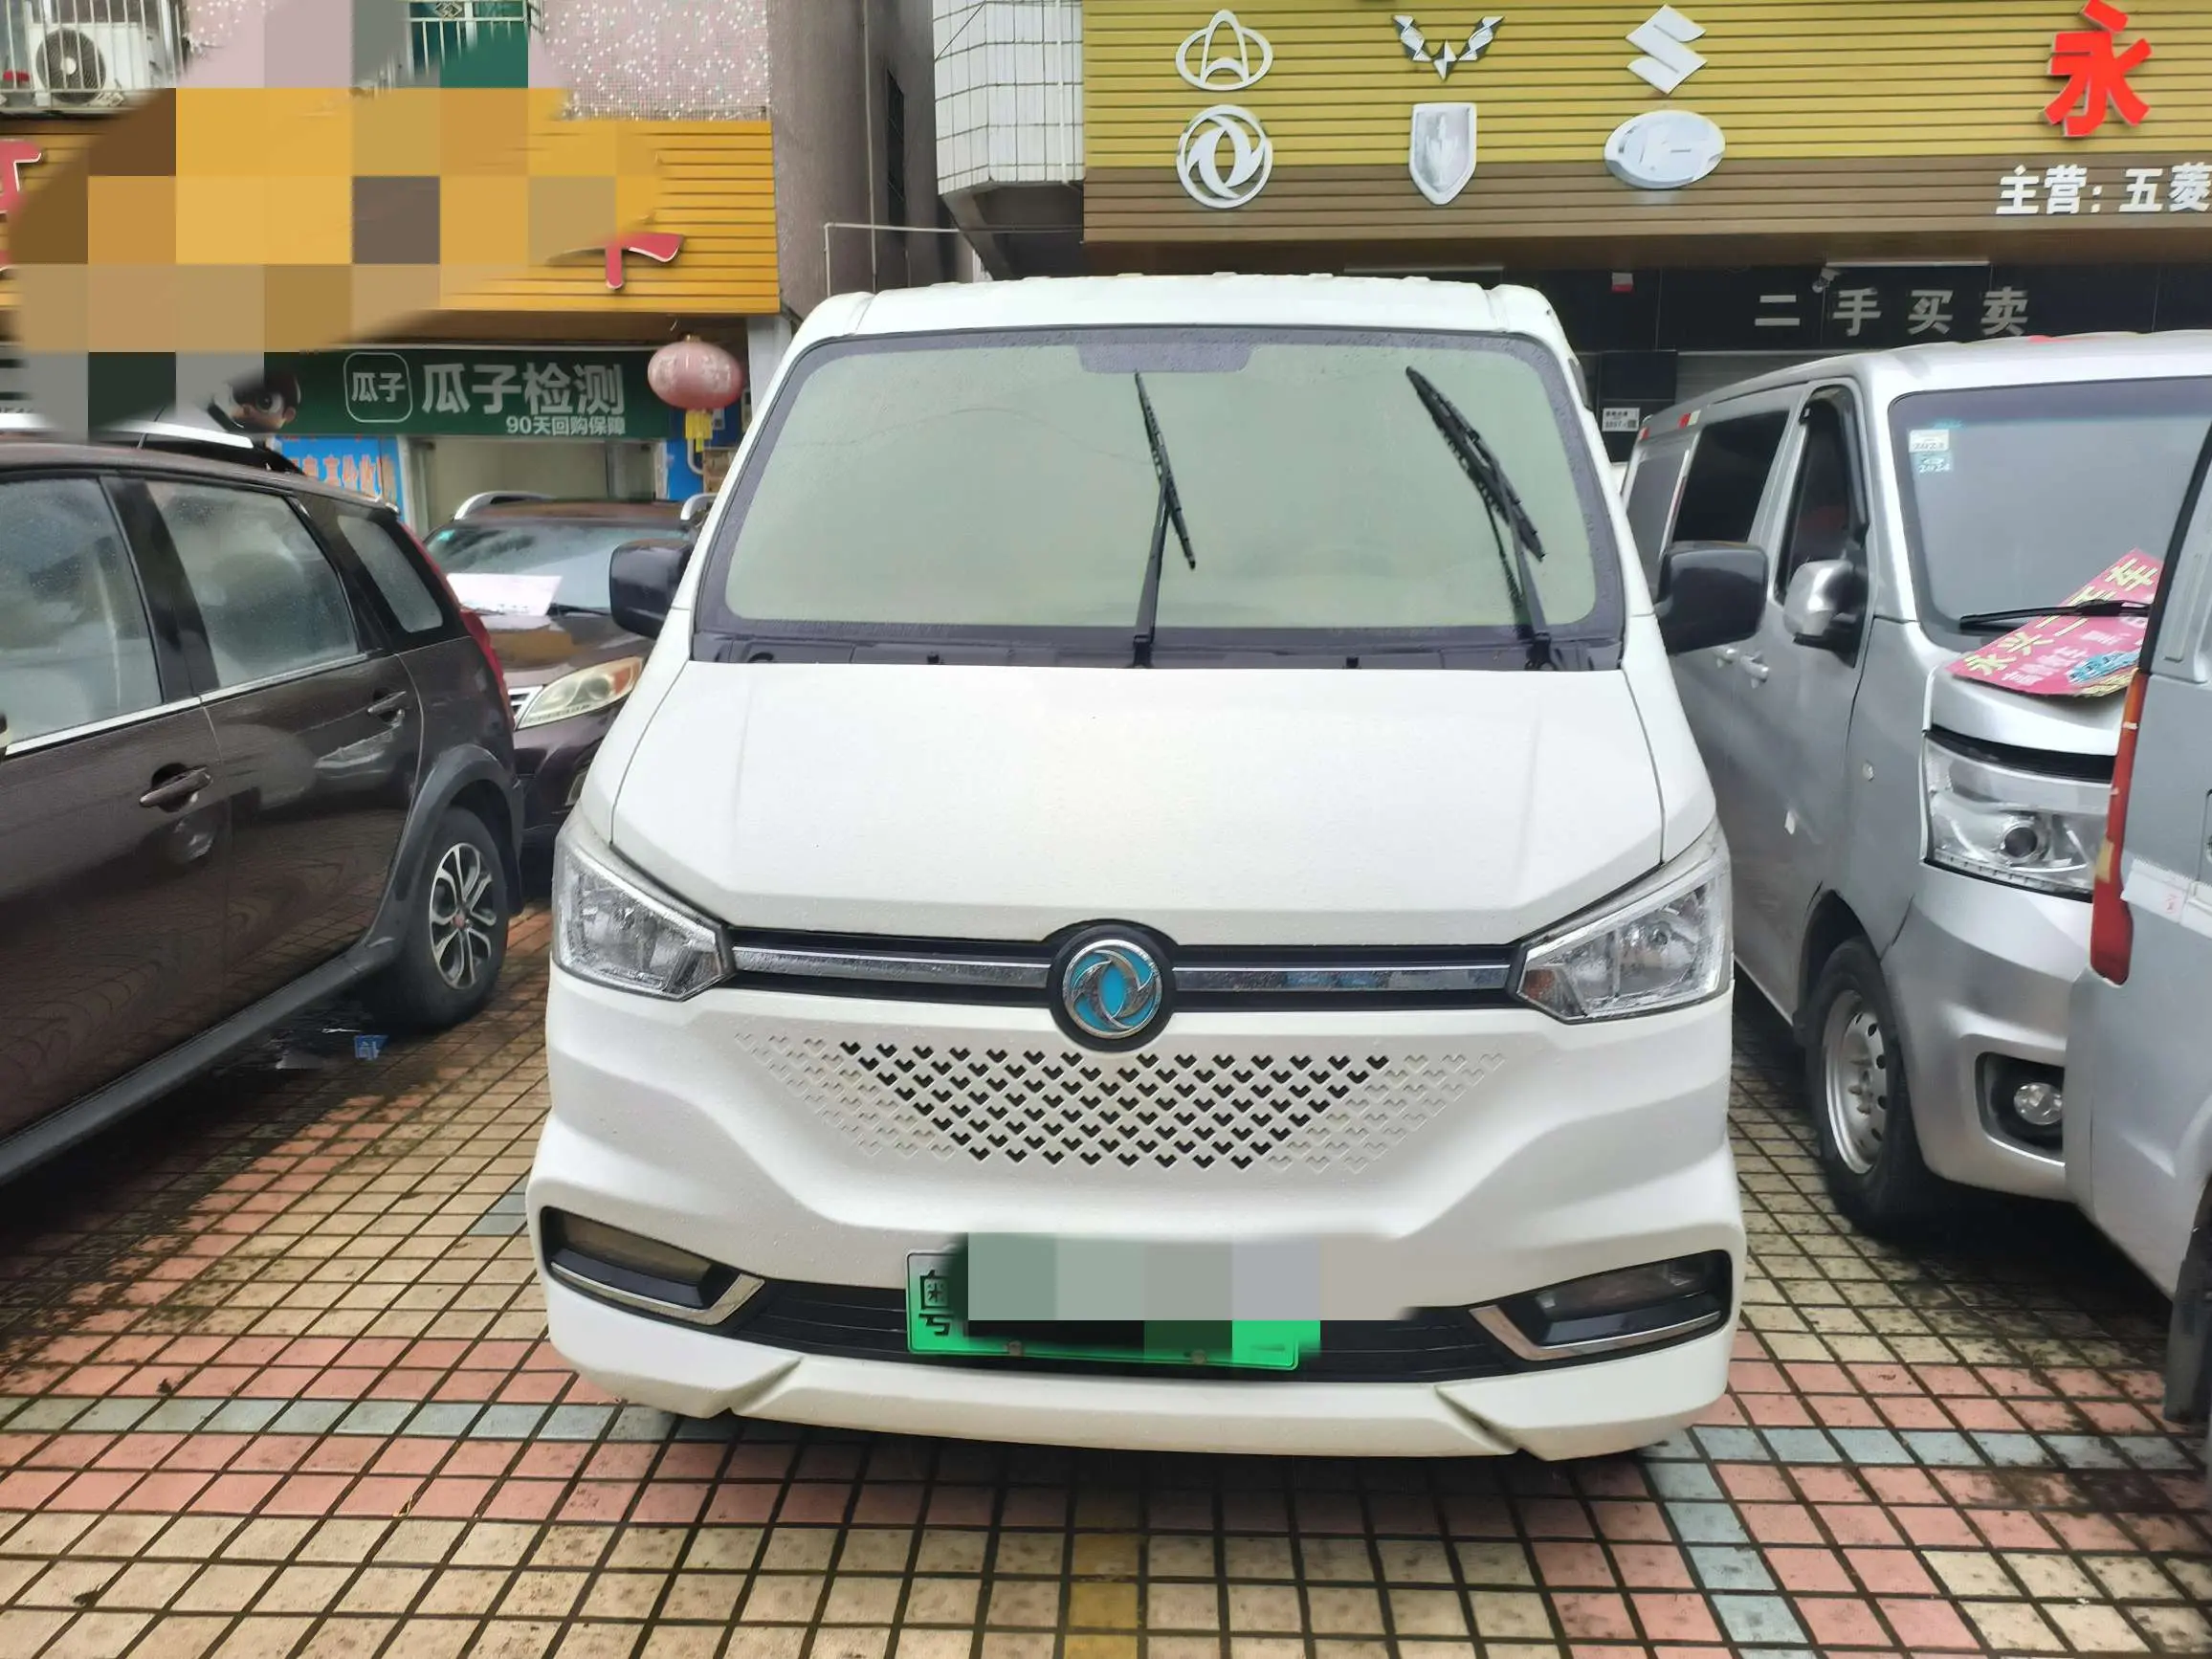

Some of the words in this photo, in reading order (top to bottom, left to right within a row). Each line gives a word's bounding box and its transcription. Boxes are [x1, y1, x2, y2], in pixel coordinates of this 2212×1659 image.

[2044, 0, 2153, 138] 永
[1754, 286, 2029, 337] 二手买卖
[351, 371, 406, 403] 瓜子
[421, 362, 626, 415] 瓜子检测
[505, 414, 627, 436] 90天回购保障
